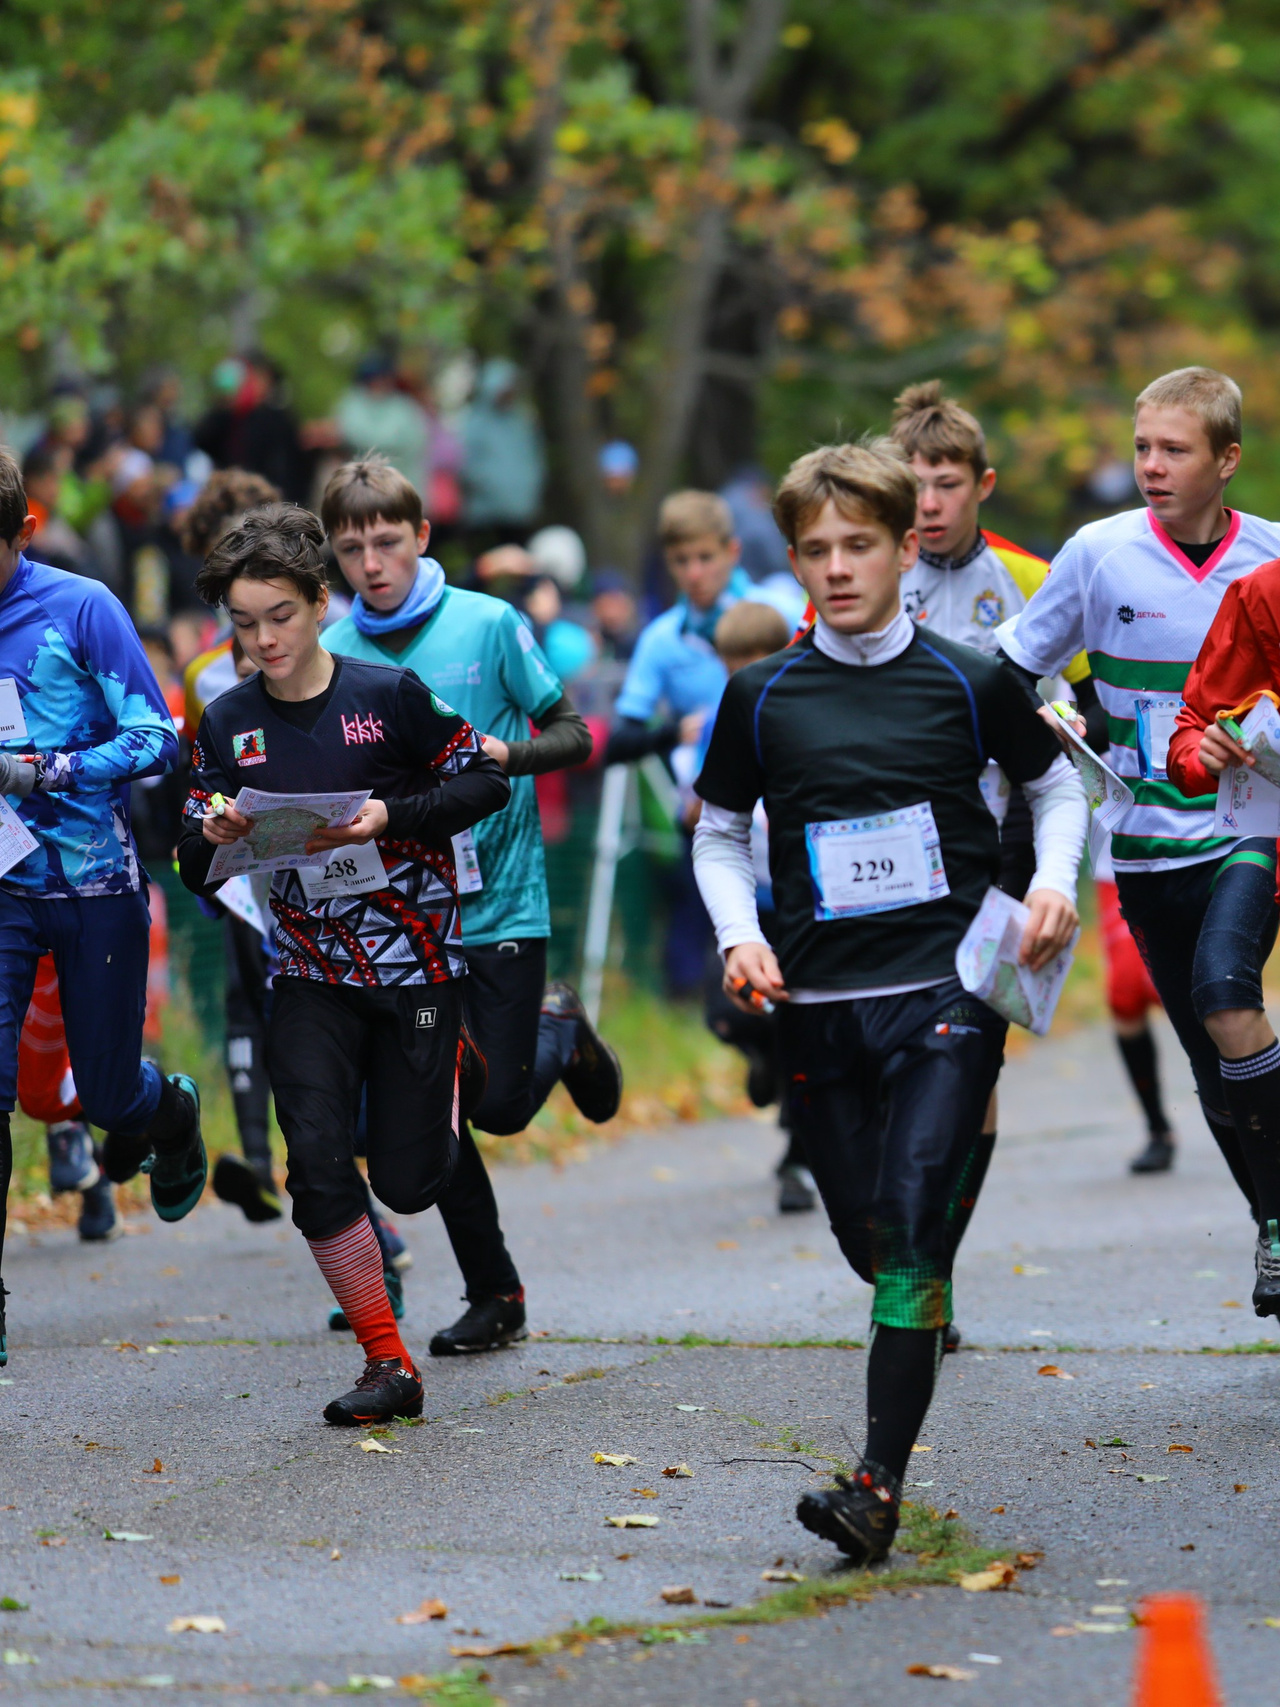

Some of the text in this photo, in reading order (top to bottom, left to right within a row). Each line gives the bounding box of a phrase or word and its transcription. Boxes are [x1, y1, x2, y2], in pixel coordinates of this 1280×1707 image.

[1136, 611, 1167, 619] ДЕТАЛЬ
[323, 858, 358, 880] 238
[851, 857, 894, 882] 229
[343, 874, 376, 887] 2 линия
